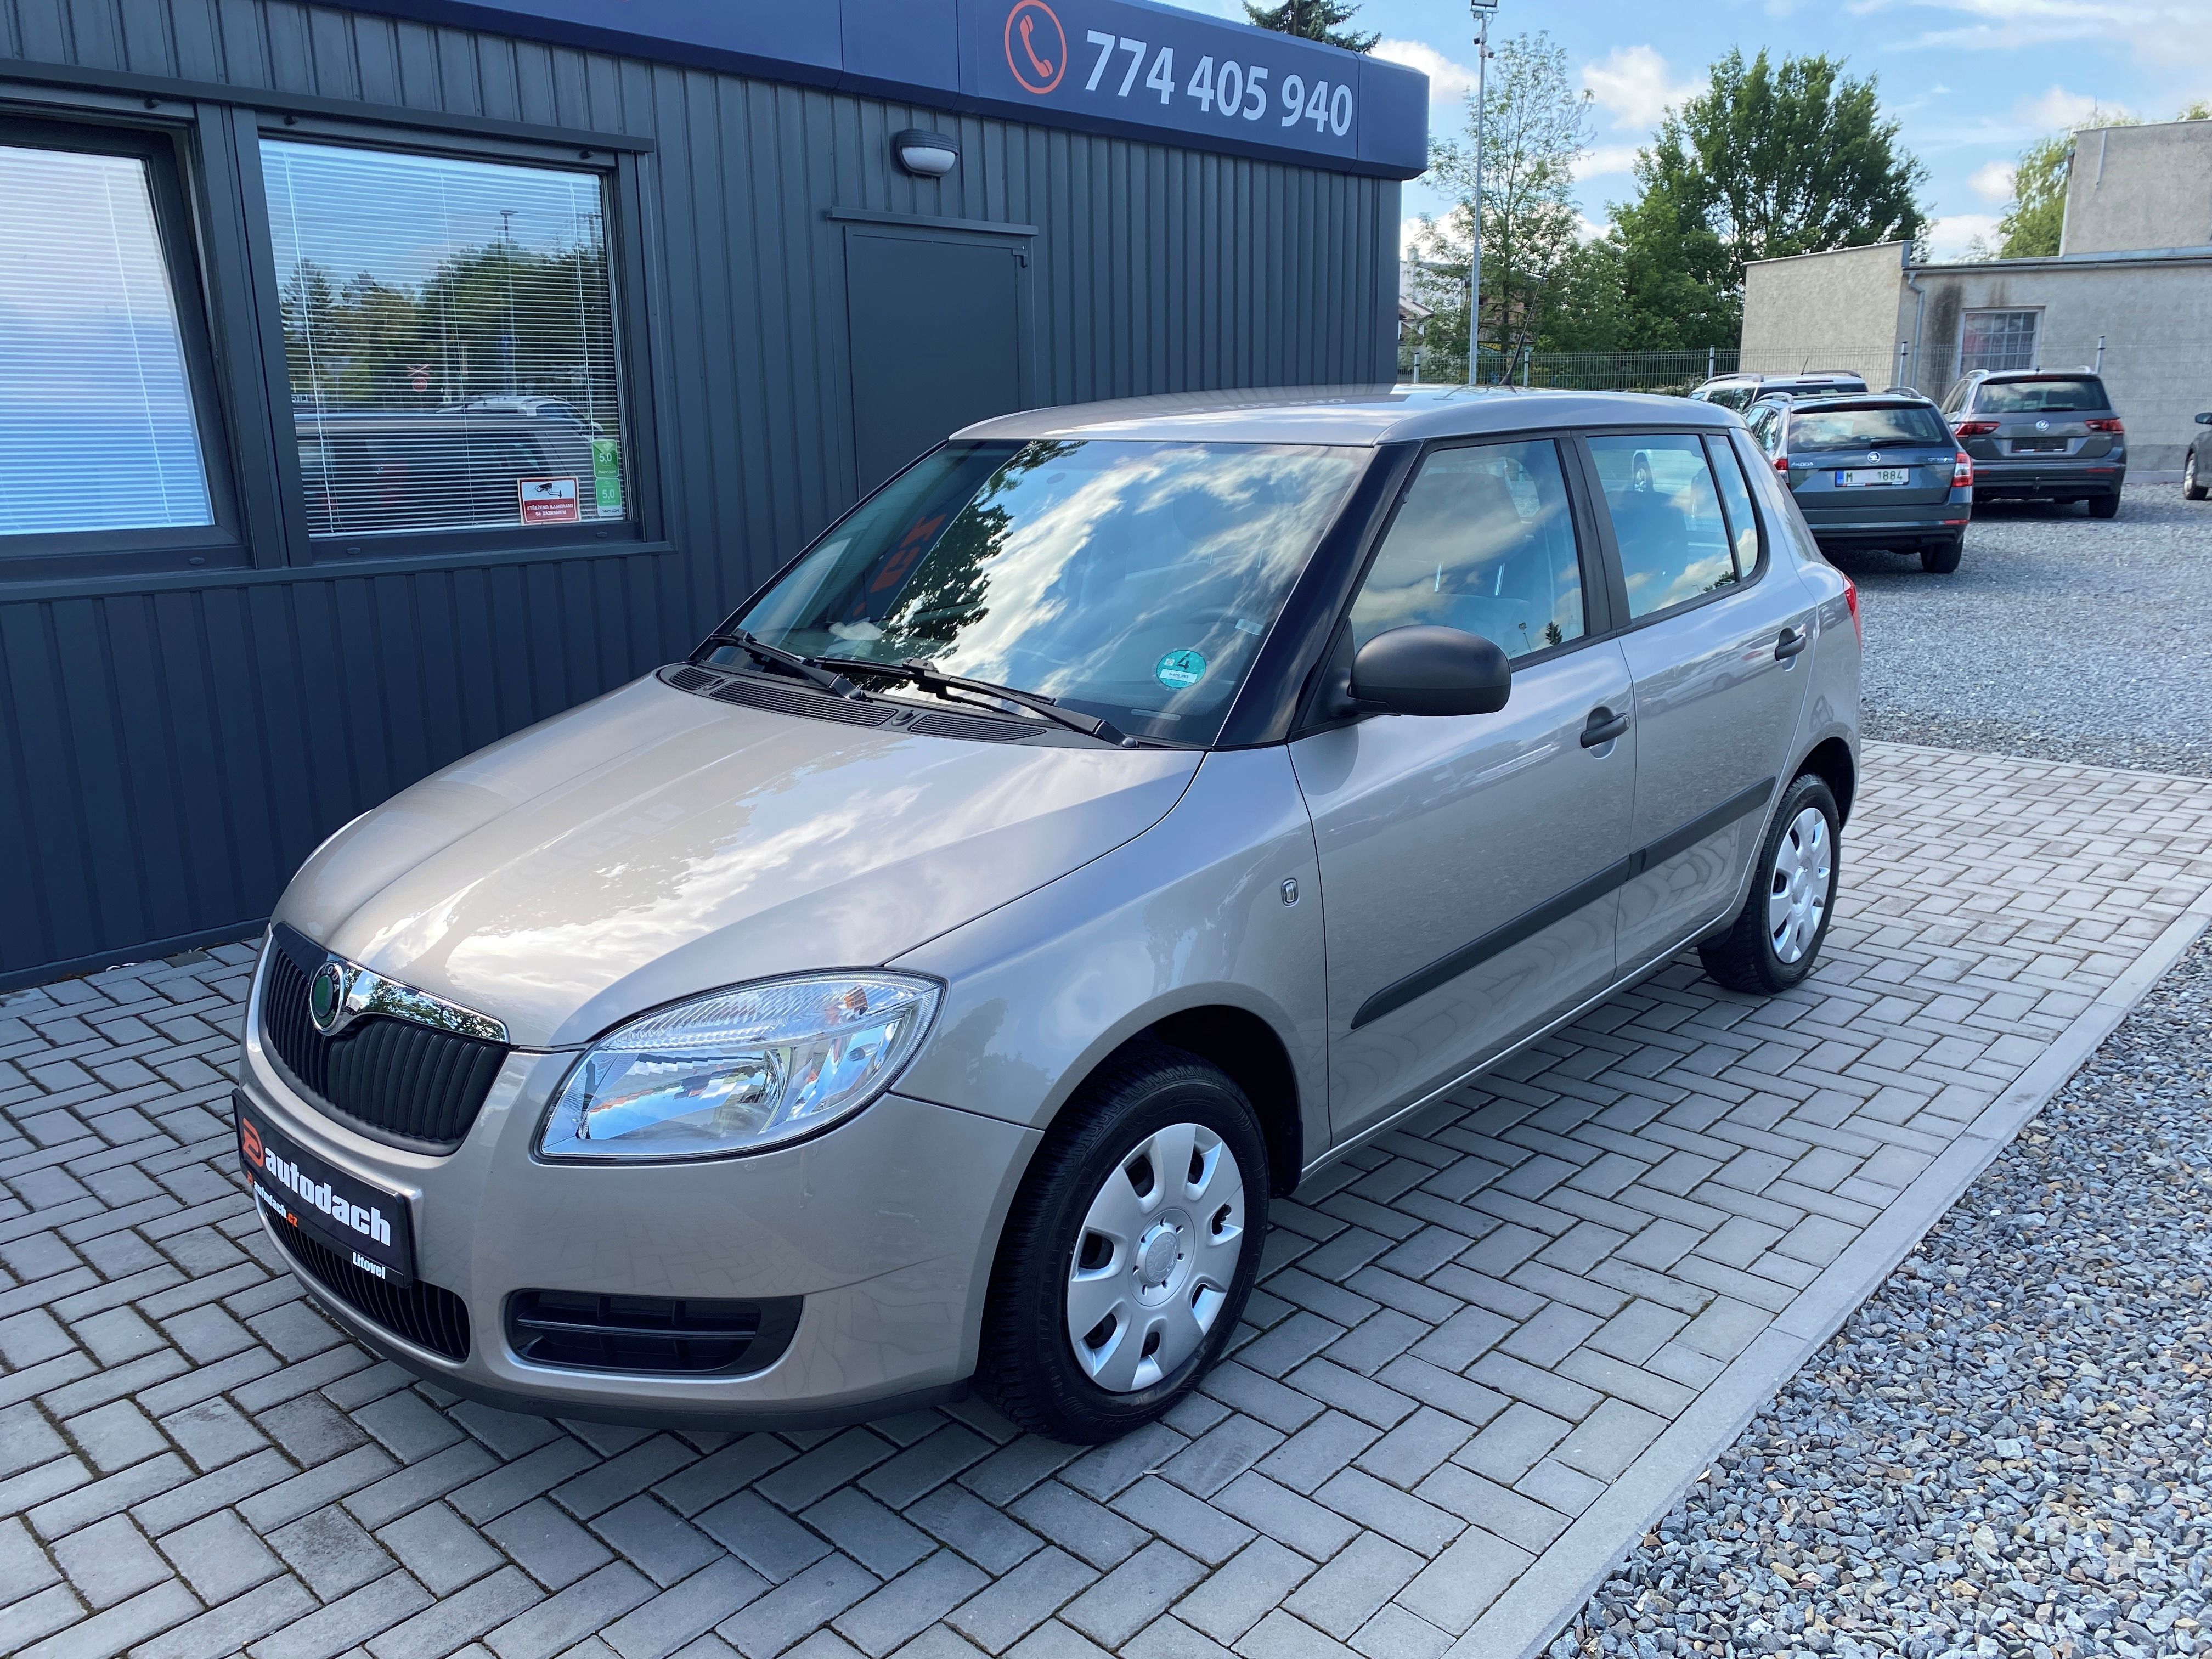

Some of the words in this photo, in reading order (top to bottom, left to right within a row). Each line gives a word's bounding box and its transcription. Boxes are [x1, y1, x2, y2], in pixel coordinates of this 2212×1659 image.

[1085, 30, 1175, 104] 774
[1187, 55, 1268, 121] 405
[1282, 74, 1353, 136] 940
[599, 453, 612, 464] 5,0
[1878, 470, 1903, 481] 1884
[602, 489, 615, 500] 5,0
[1176, 653, 1190, 670] 4
[265, 1147, 391, 1246] autodach
[352, 1251, 386, 1279] Litovel
